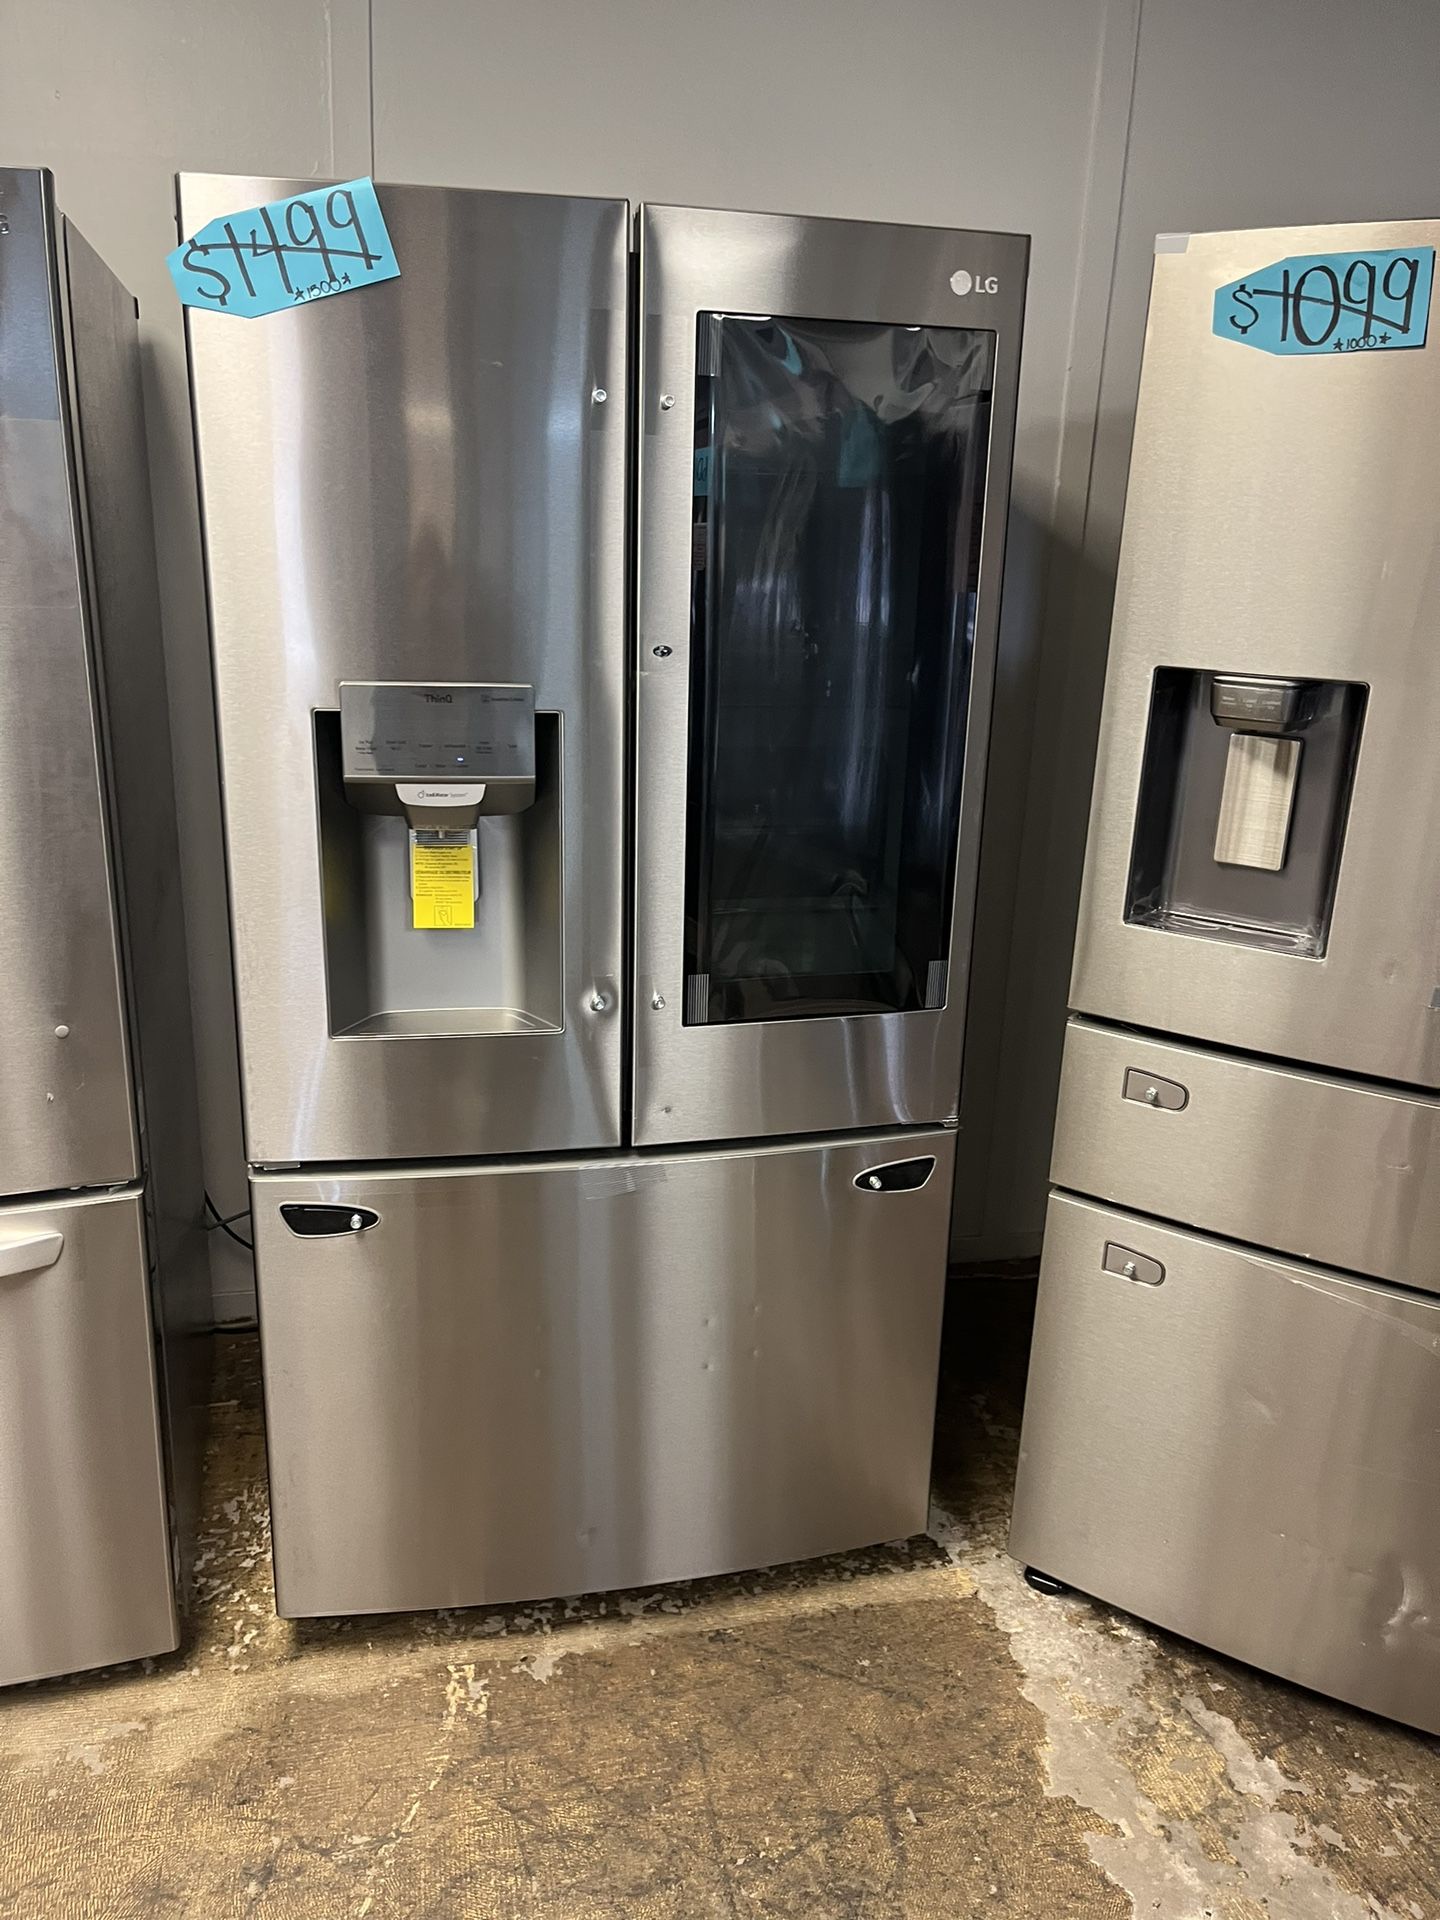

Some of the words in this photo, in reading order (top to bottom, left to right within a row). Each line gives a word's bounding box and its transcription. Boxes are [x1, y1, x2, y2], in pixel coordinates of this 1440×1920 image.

[182, 189, 374, 306] $1499
[975, 275, 998, 294] LG
[1229, 257, 1420, 347] $1099
[424, 693, 453, 704] ThinQ
